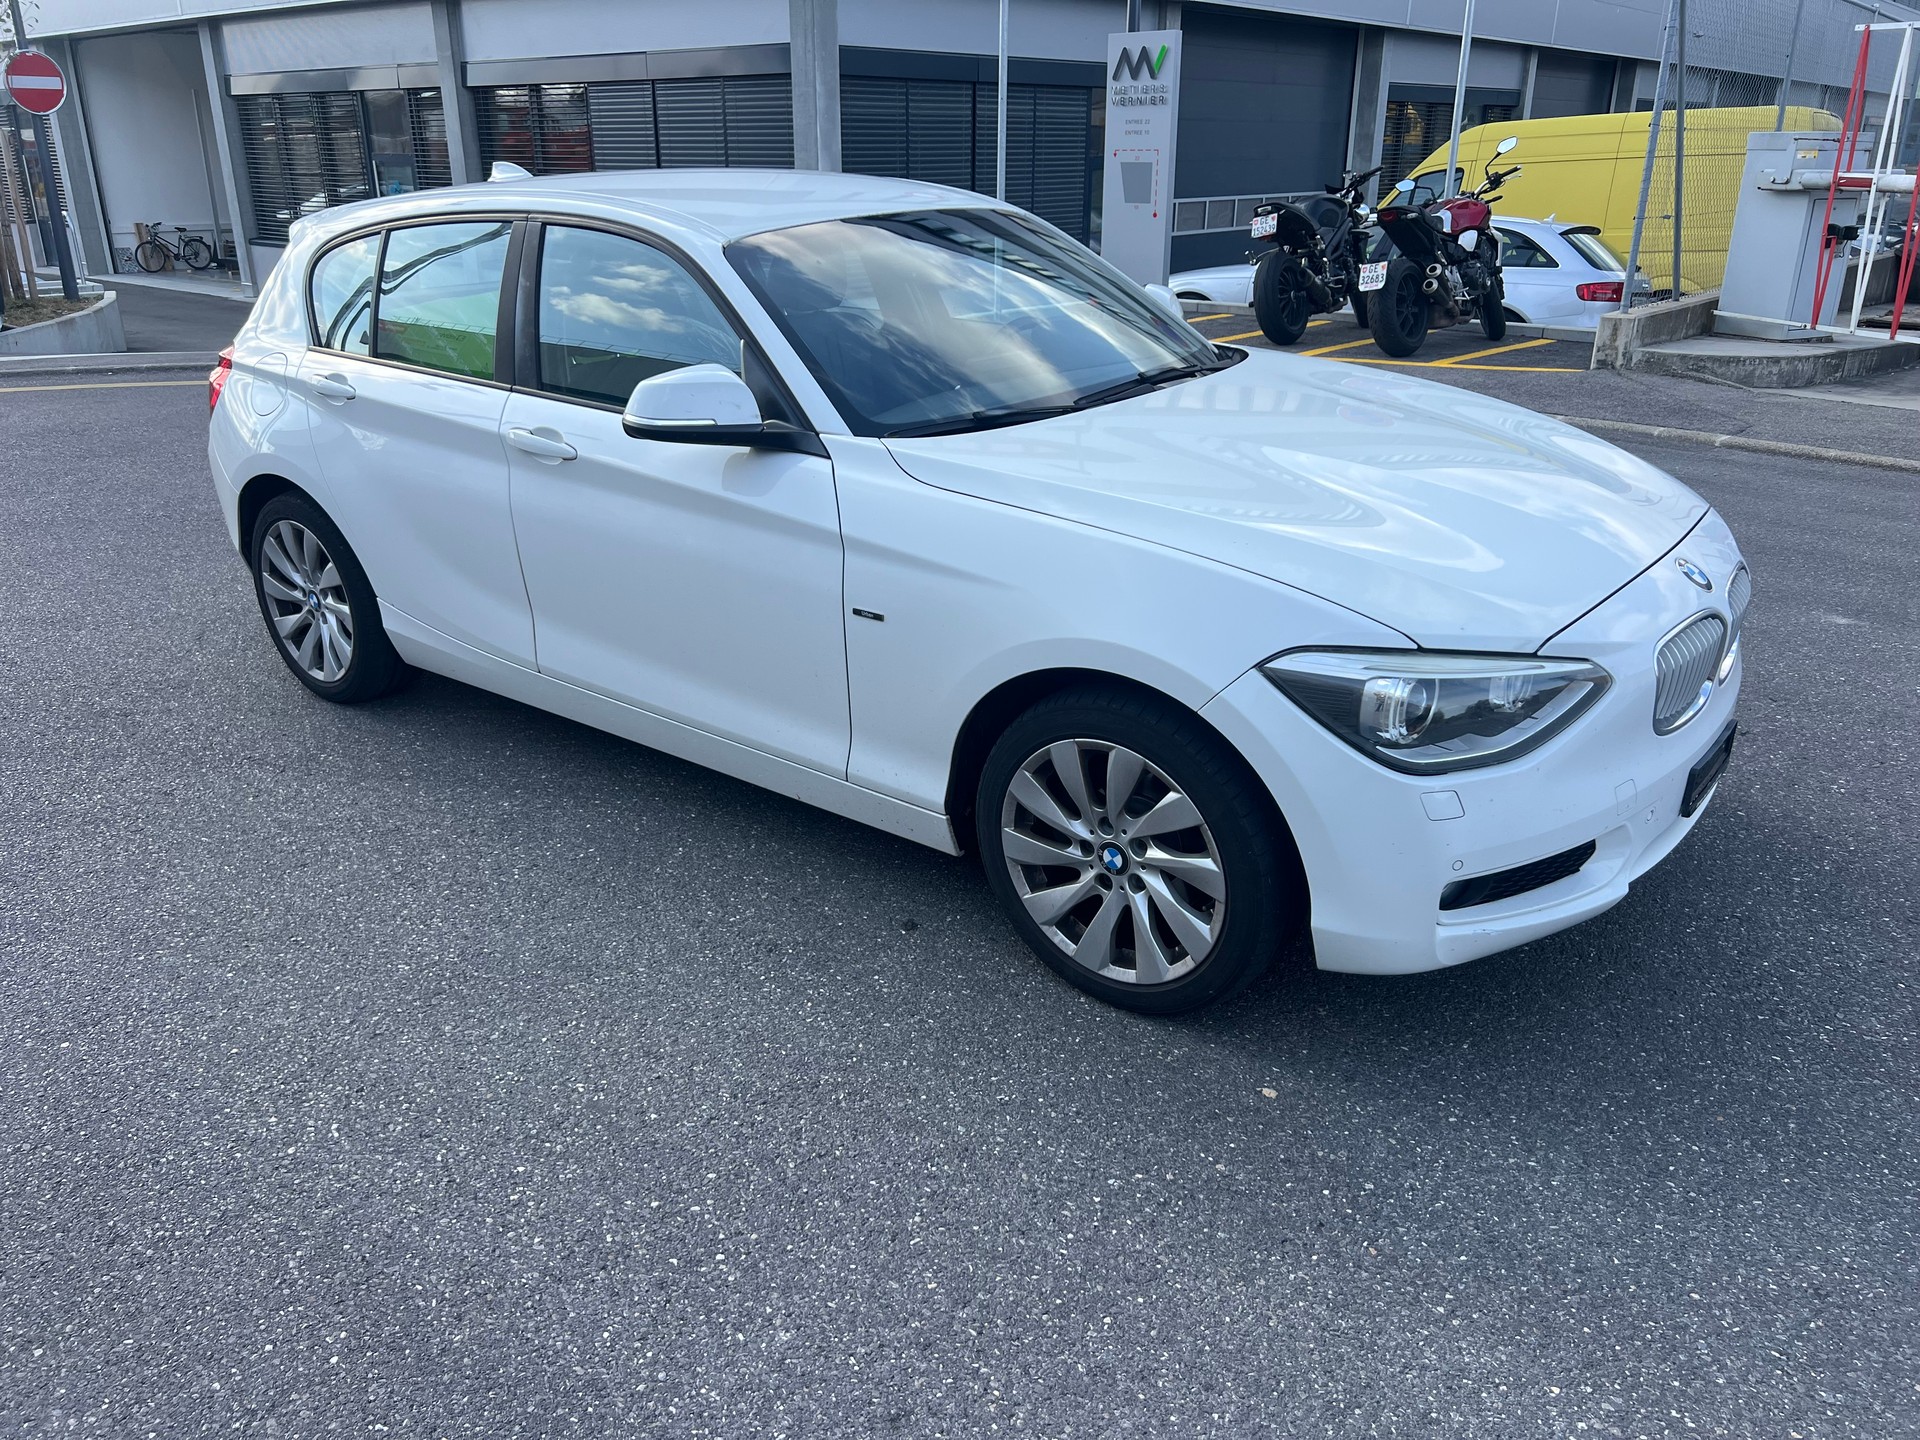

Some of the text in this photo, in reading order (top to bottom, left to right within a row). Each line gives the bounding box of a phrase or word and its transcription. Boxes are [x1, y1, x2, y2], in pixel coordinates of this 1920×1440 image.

[1111, 95, 1167, 106] VERNIER
[1260, 216, 1269, 225] GE
[1369, 264, 1379, 273] GE
[1361, 273, 1385, 285] 32683
